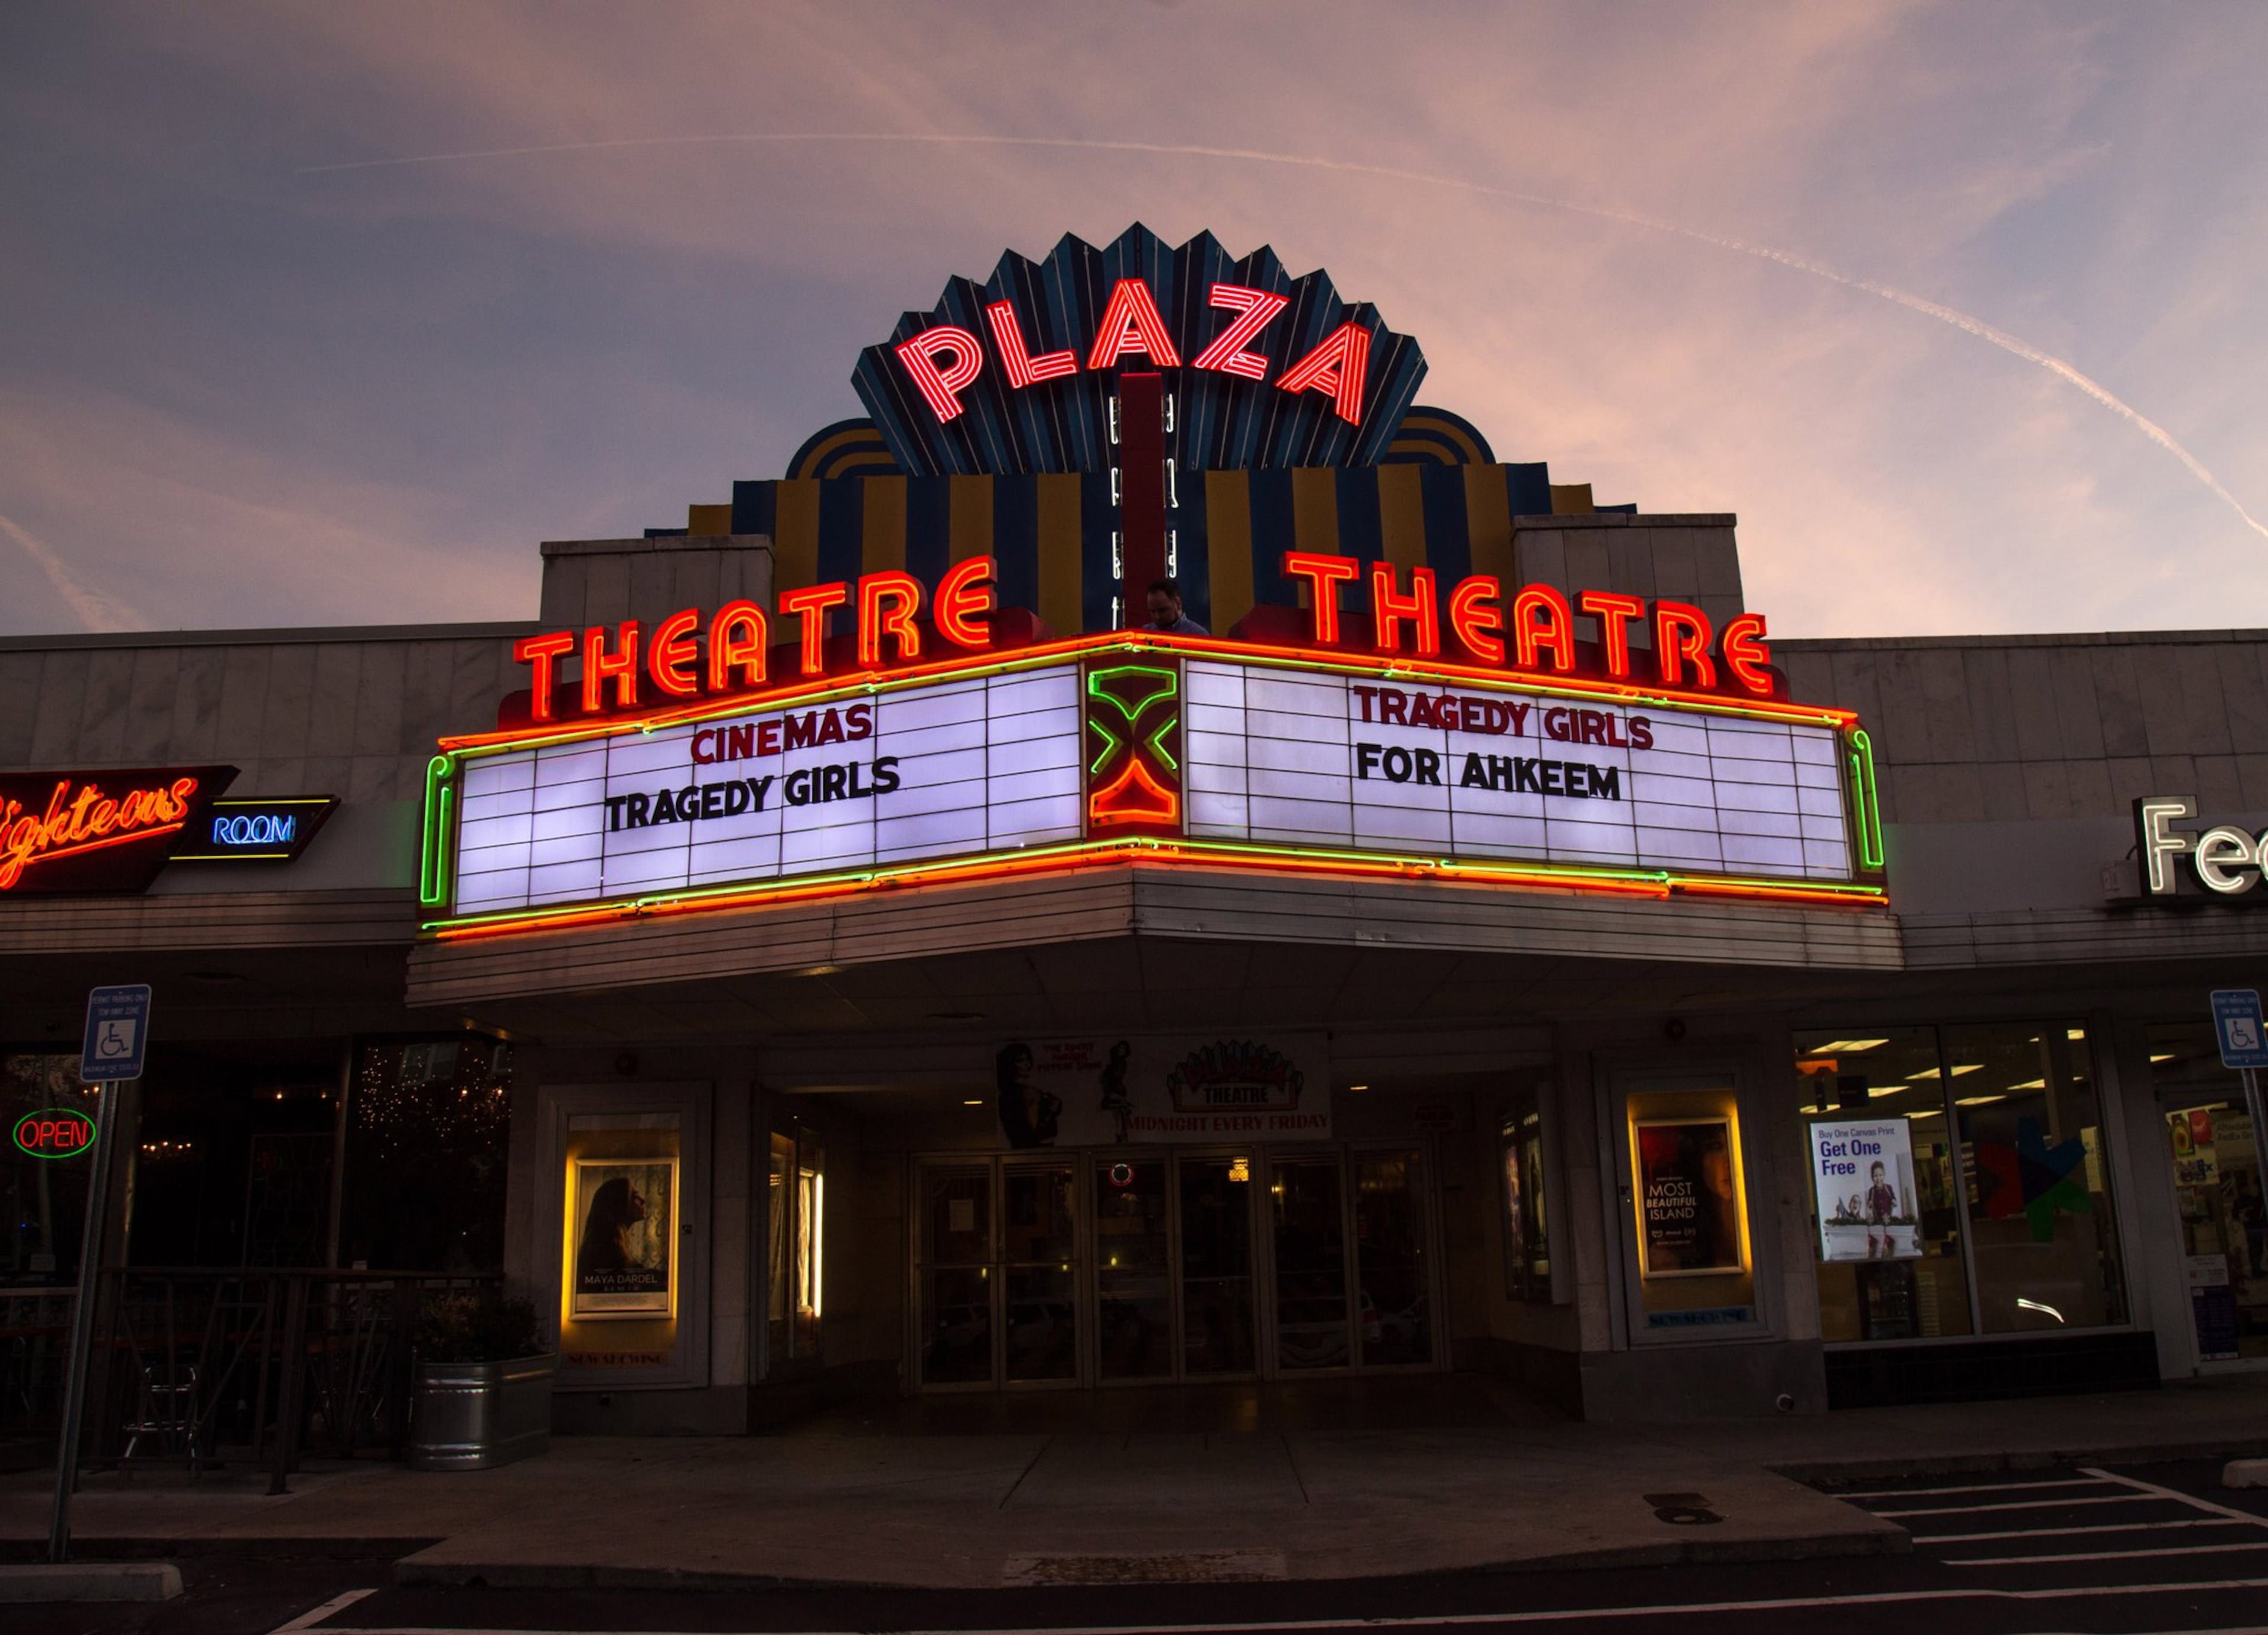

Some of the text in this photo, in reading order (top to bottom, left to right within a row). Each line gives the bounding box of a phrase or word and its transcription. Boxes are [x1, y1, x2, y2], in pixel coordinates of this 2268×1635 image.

[895, 279, 1371, 426] PLAZA
[1282, 551, 1773, 696] THEATRE
[514, 554, 998, 722] THEATRE
[1354, 686, 1654, 750] TRAGEDY GIRLS
[690, 703, 872, 764] CINEMAS
[1357, 742, 1620, 801] FOR AHKEEM
[605, 756, 901, 832] TRAGEDY GIRLS
[0, 778, 295, 890] ighteous ROOM
[2133, 795, 2268, 895] Fe
[1203, 1086, 1268, 1104] THEATRE
[19, 1120, 88, 1148] OPEN
[1127, 1114, 1329, 1132] MIDNIGHT EVERY FRIDAY
[1819, 1127, 1895, 1140] Buy One Canvas Print
[1820, 1140, 1881, 1157] Get One
[1822, 1158, 1856, 1176] Free
[1645, 1196, 1698, 1209] BEAUTIFUL
[1648, 1182, 1693, 1197] MOST
[1650, 1206, 1695, 1221] ISLAND
[584, 1274, 658, 1285] MAYA DARDEL
